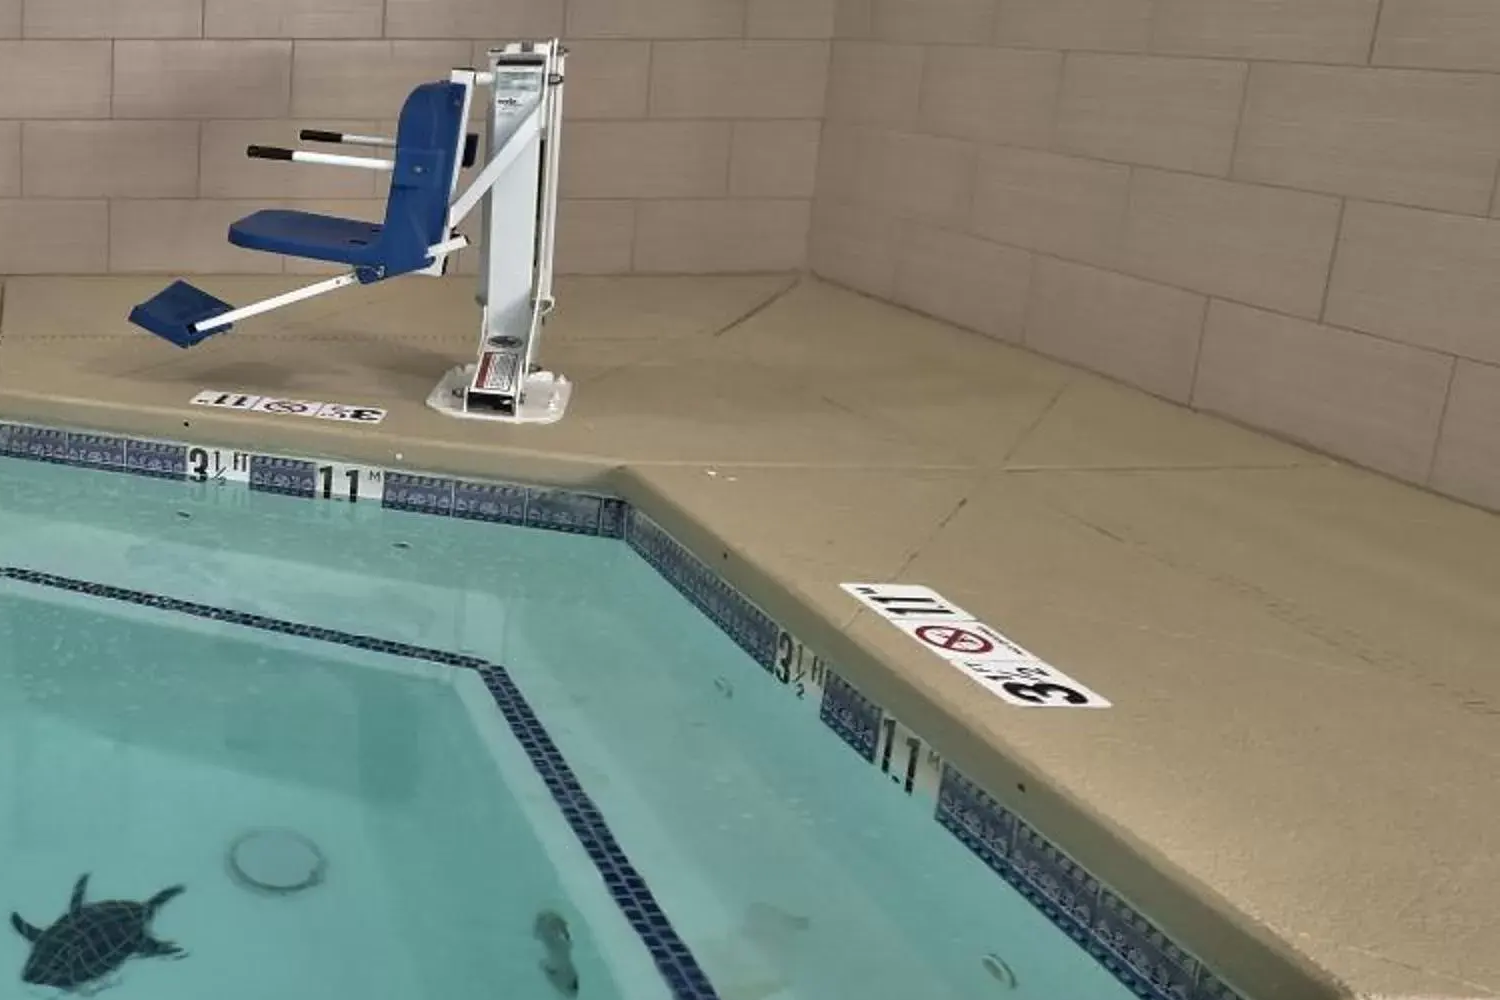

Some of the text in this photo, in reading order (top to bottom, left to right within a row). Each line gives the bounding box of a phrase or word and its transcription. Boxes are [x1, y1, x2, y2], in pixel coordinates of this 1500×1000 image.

[190, 448, 208, 483] 3
[369, 470, 381, 482] M
[774, 631, 794, 685] 3
[1002, 682, 1089, 704] 3
